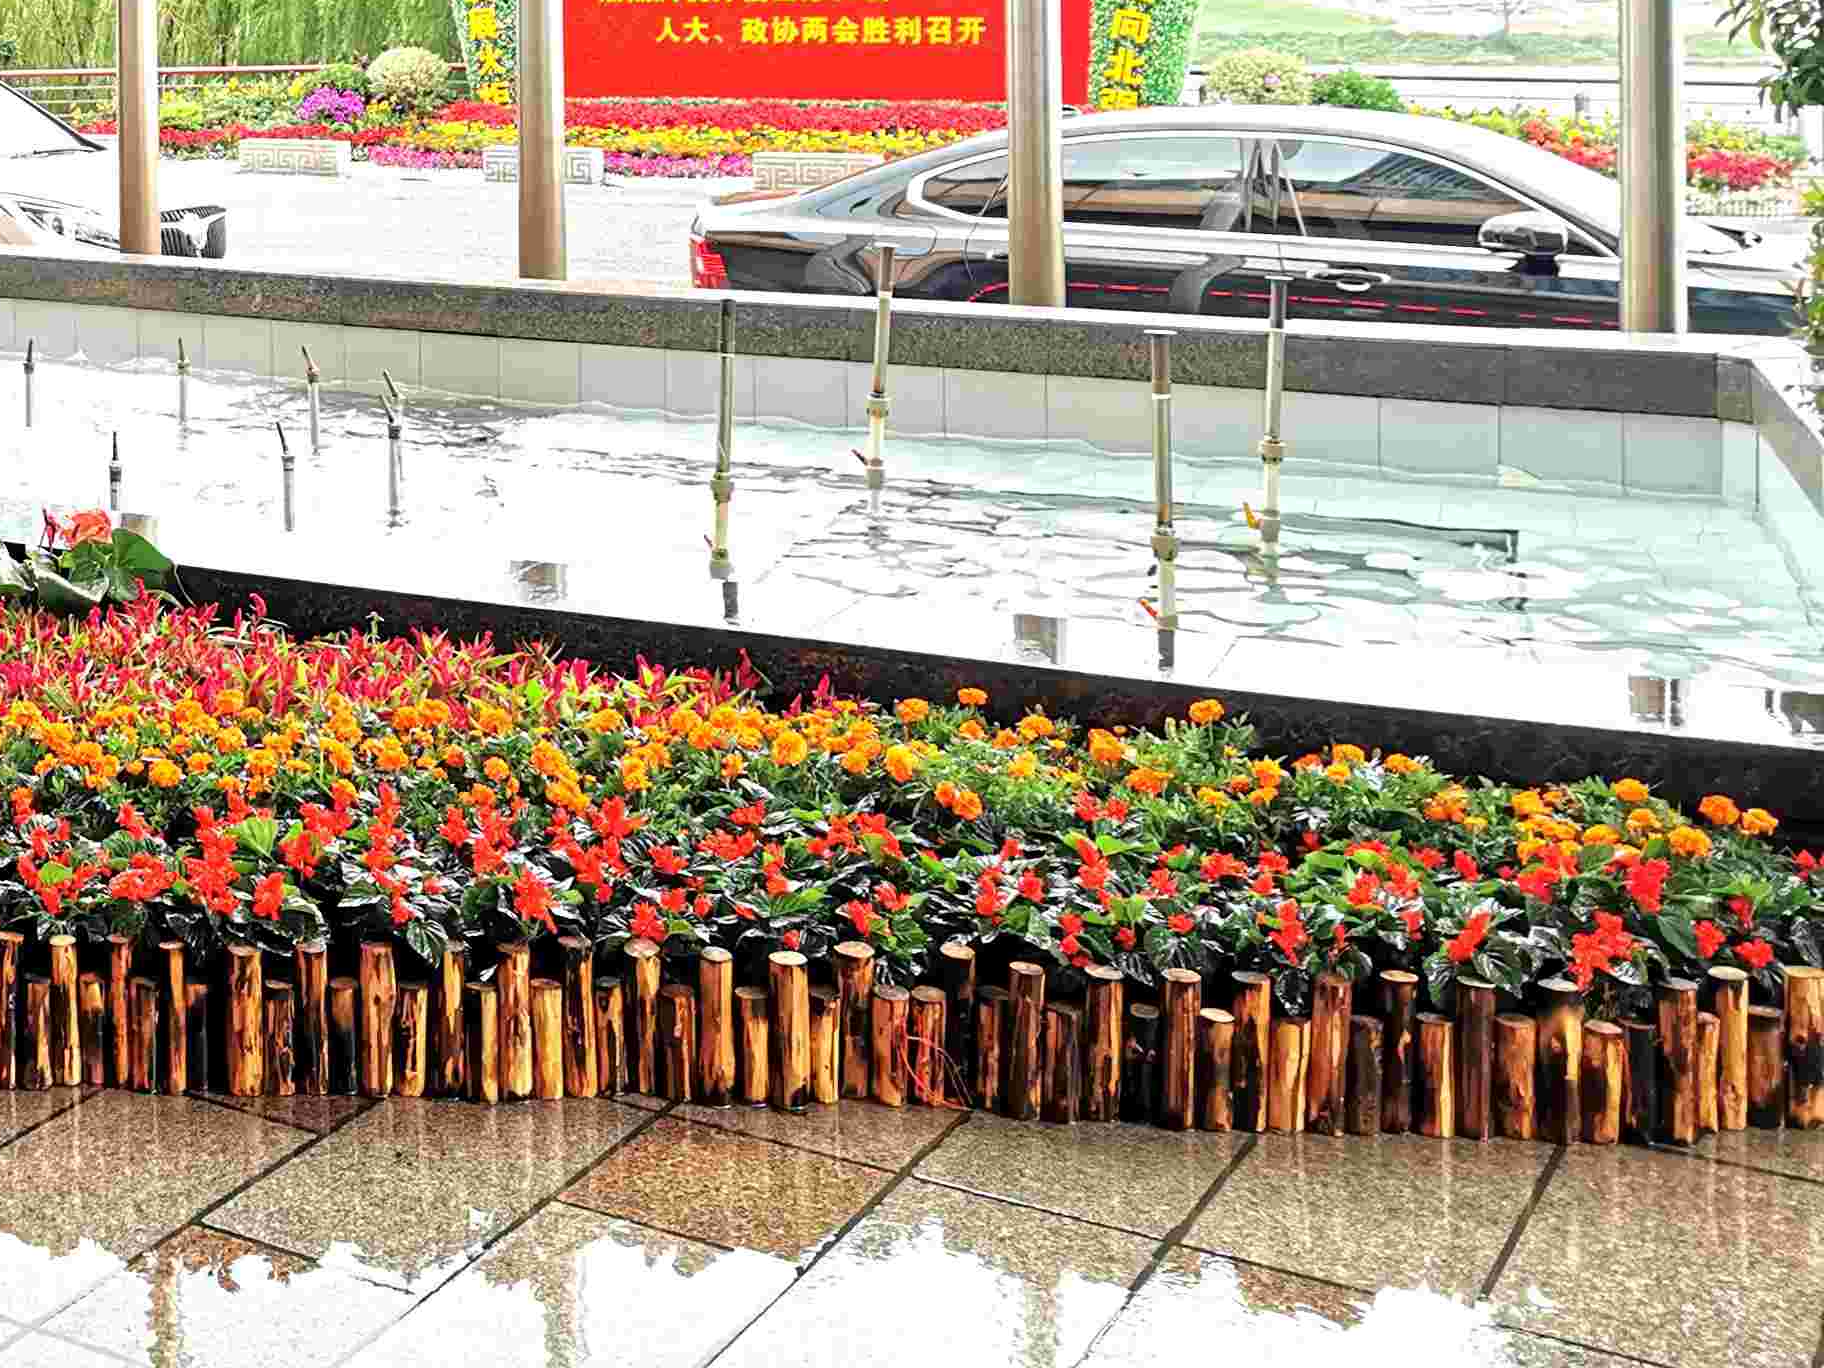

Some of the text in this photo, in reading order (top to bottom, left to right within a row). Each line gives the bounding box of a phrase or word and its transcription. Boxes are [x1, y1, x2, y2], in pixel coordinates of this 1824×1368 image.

[655, 15, 985, 44] 人大、政协两会胜利召开
